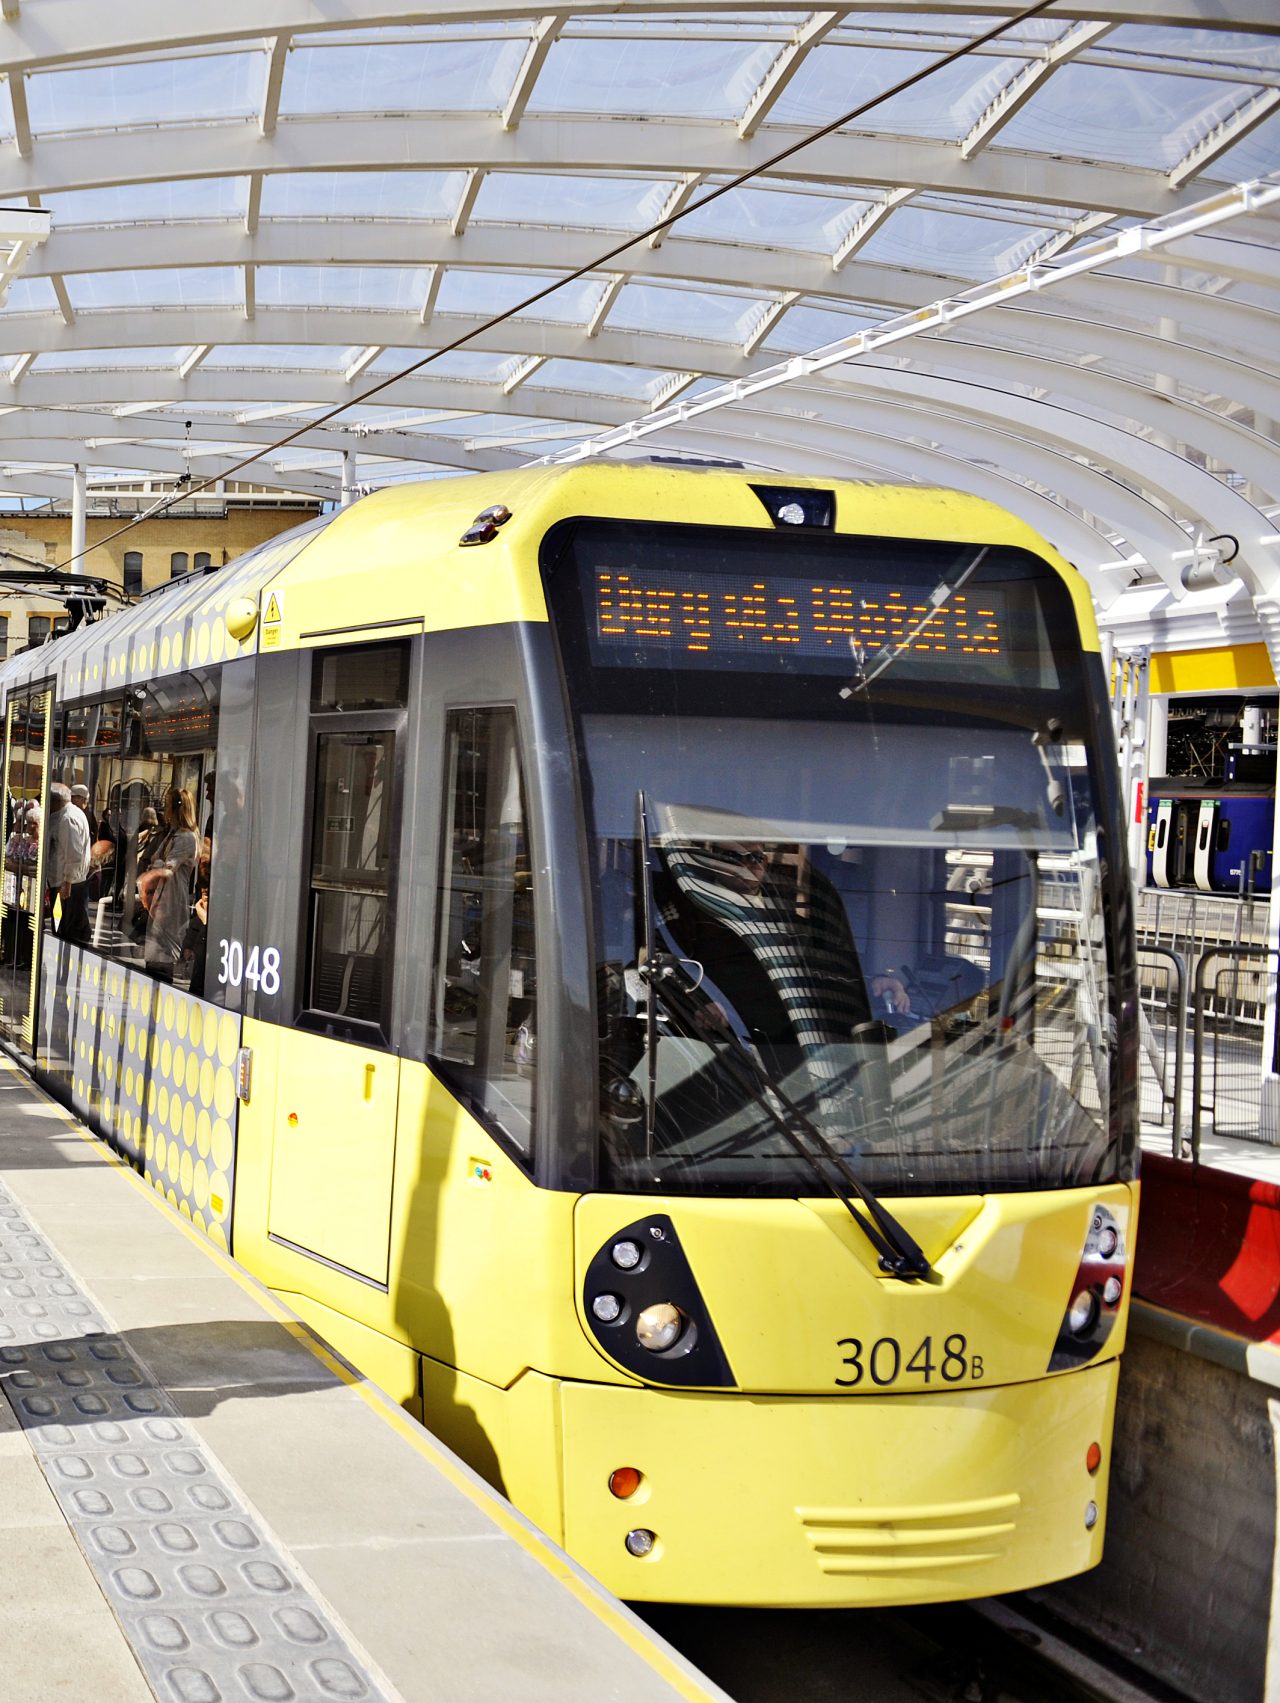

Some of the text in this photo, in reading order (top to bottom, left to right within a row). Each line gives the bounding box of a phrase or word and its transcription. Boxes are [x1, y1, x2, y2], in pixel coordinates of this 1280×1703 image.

[599, 575, 1000, 653] Bury via Victoria
[217, 938, 282, 997] 3048
